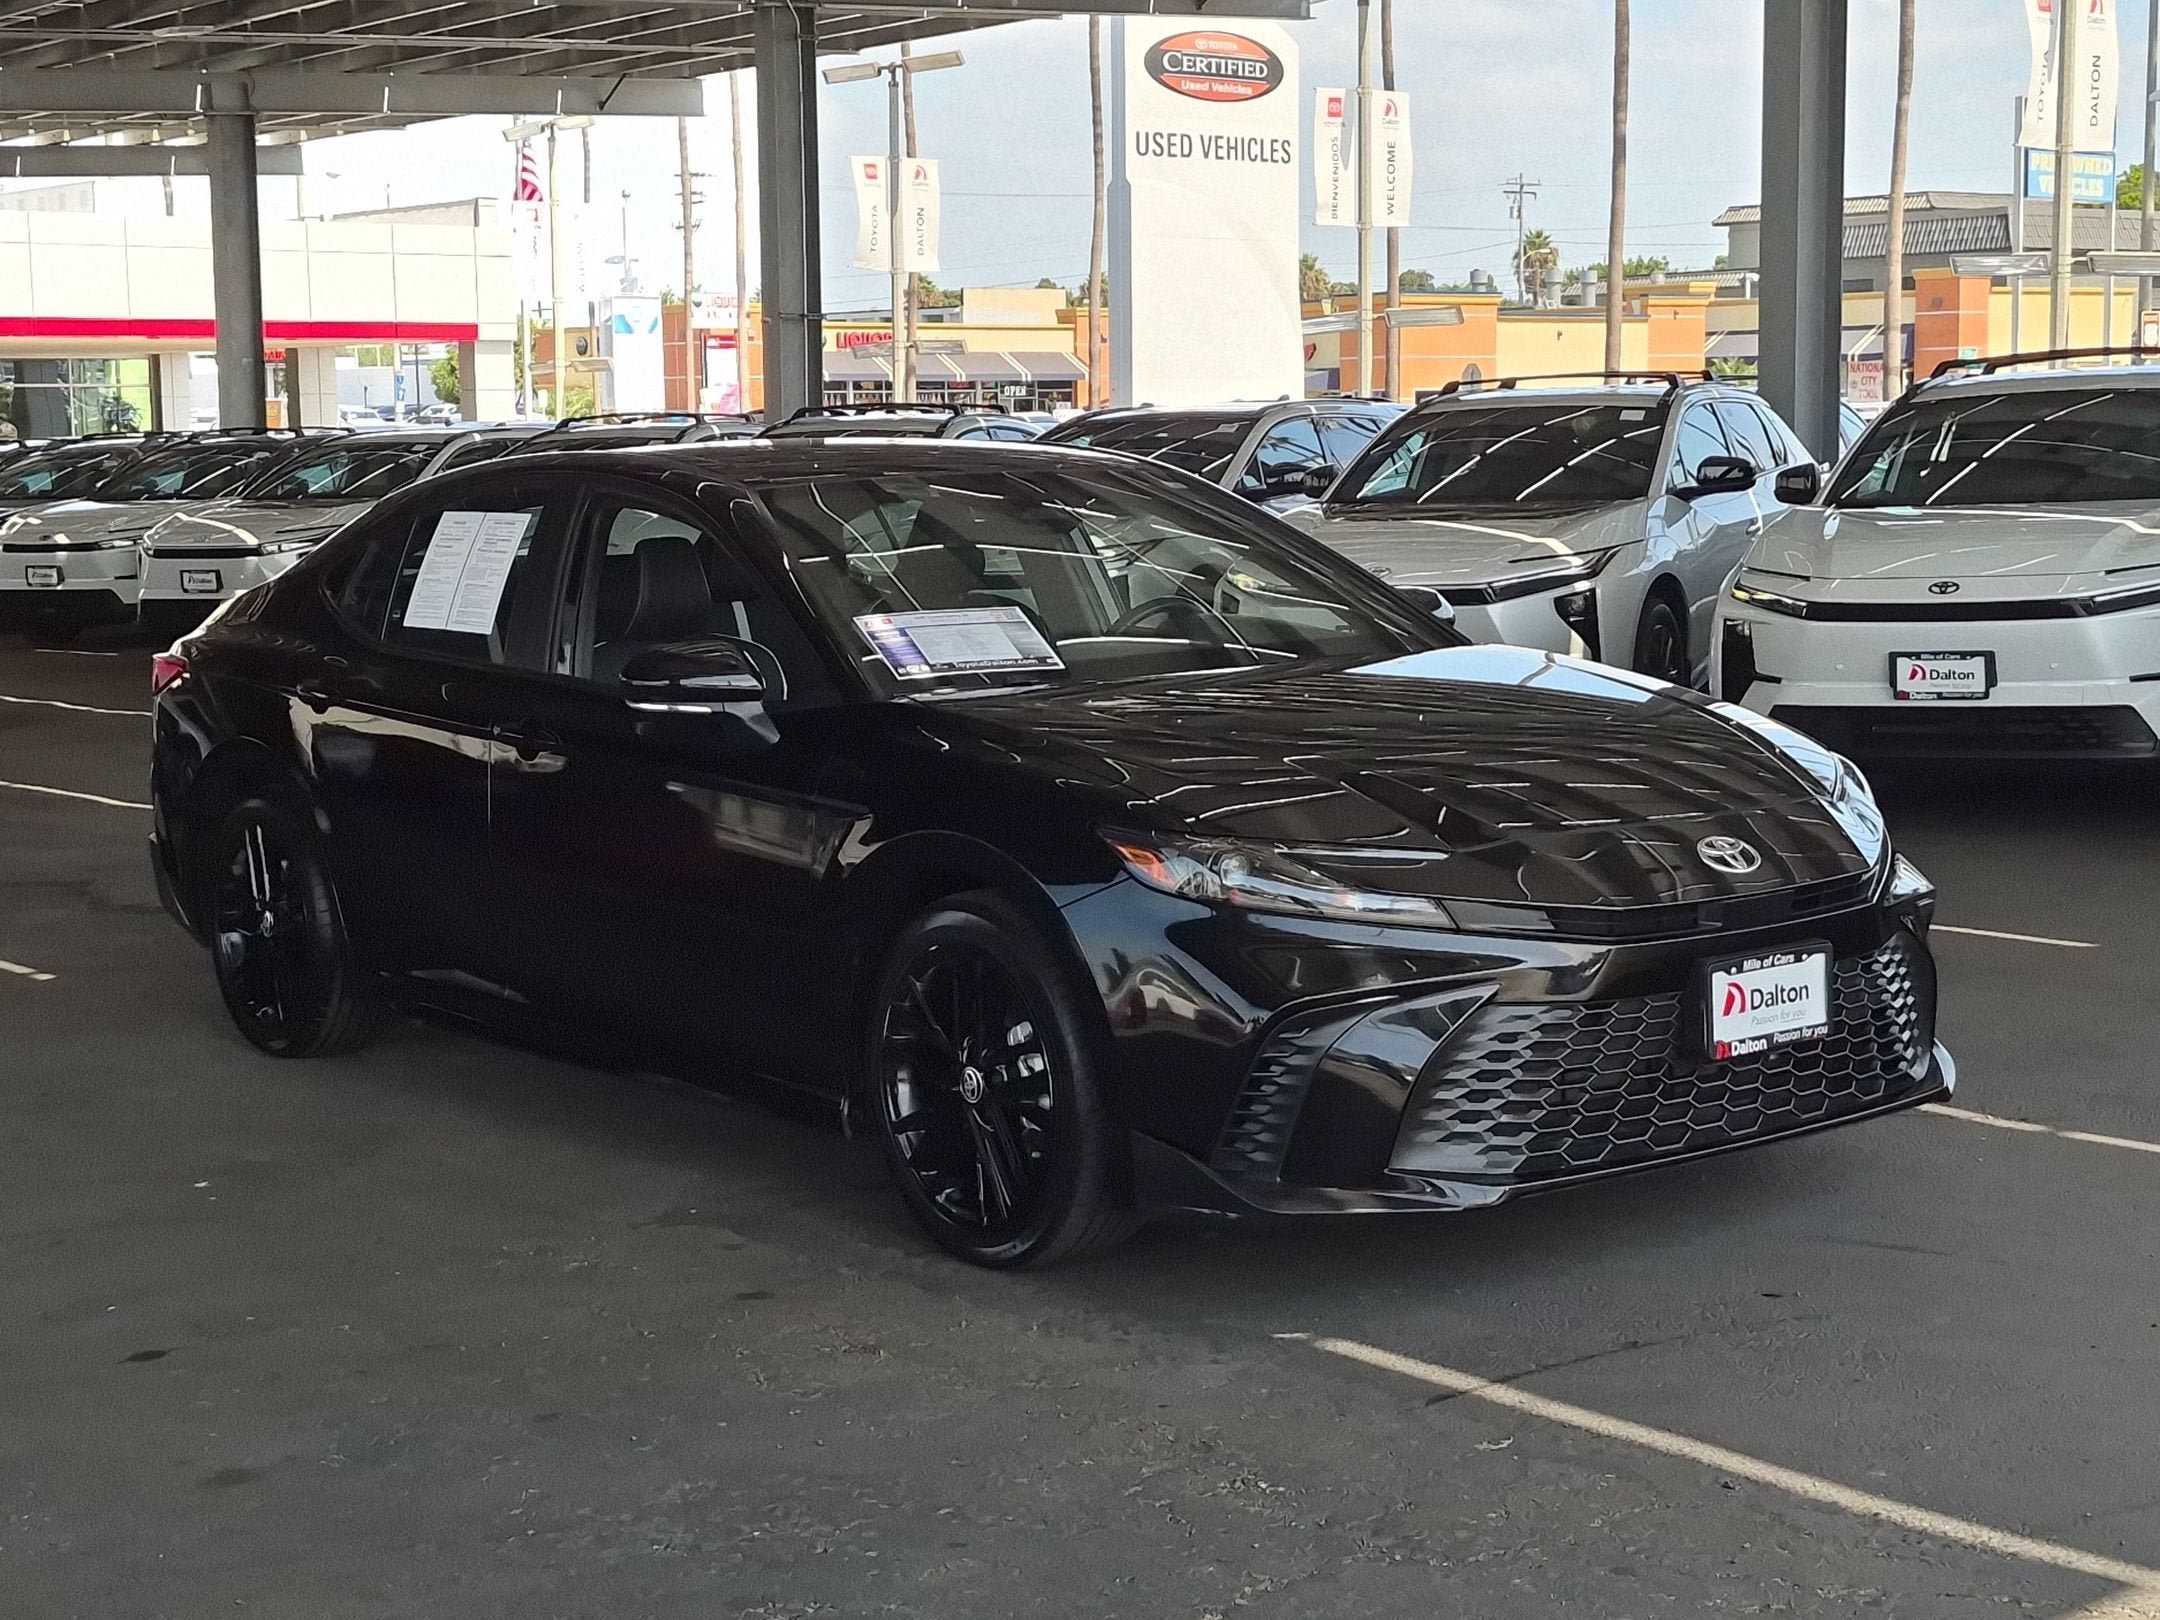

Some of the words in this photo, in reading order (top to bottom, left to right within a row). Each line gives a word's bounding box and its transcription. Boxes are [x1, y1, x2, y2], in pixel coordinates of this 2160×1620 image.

[1208, 39, 1239, 50] TOYOTA
[1162, 51, 1268, 78] CERTIFIED
[1181, 79, 1210, 91] Used
[1211, 82, 1253, 95] Vehicles
[2089, 54, 2101, 127] DALTON
[1135, 130, 1193, 158] USED
[1199, 133, 1291, 164] VEHICLES
[1330, 136, 1340, 220] BIENVENIDOS
[1386, 141, 1396, 216] WELCOME
[869, 204, 879, 254] TOYOTA
[916, 207, 925, 256] DALTON
[1004, 384, 1026, 397] OPEN
[1929, 668, 1975, 681] Dalton
[1742, 959, 1762, 972] Mile
[1762, 955, 1773, 967] of
[1773, 953, 1795, 966] Cars
[1750, 983, 1809, 1012] Dalton
[1751, 1013, 1780, 1027] Passion
[1780, 1010, 1791, 1020] for
[1791, 1009, 1806, 1019] you
[1731, 1038, 1768, 1057] Dalton
[1773, 1030, 1801, 1044] Passion
[1801, 1026, 1812, 1038] for
[1812, 1025, 1829, 1039] you
